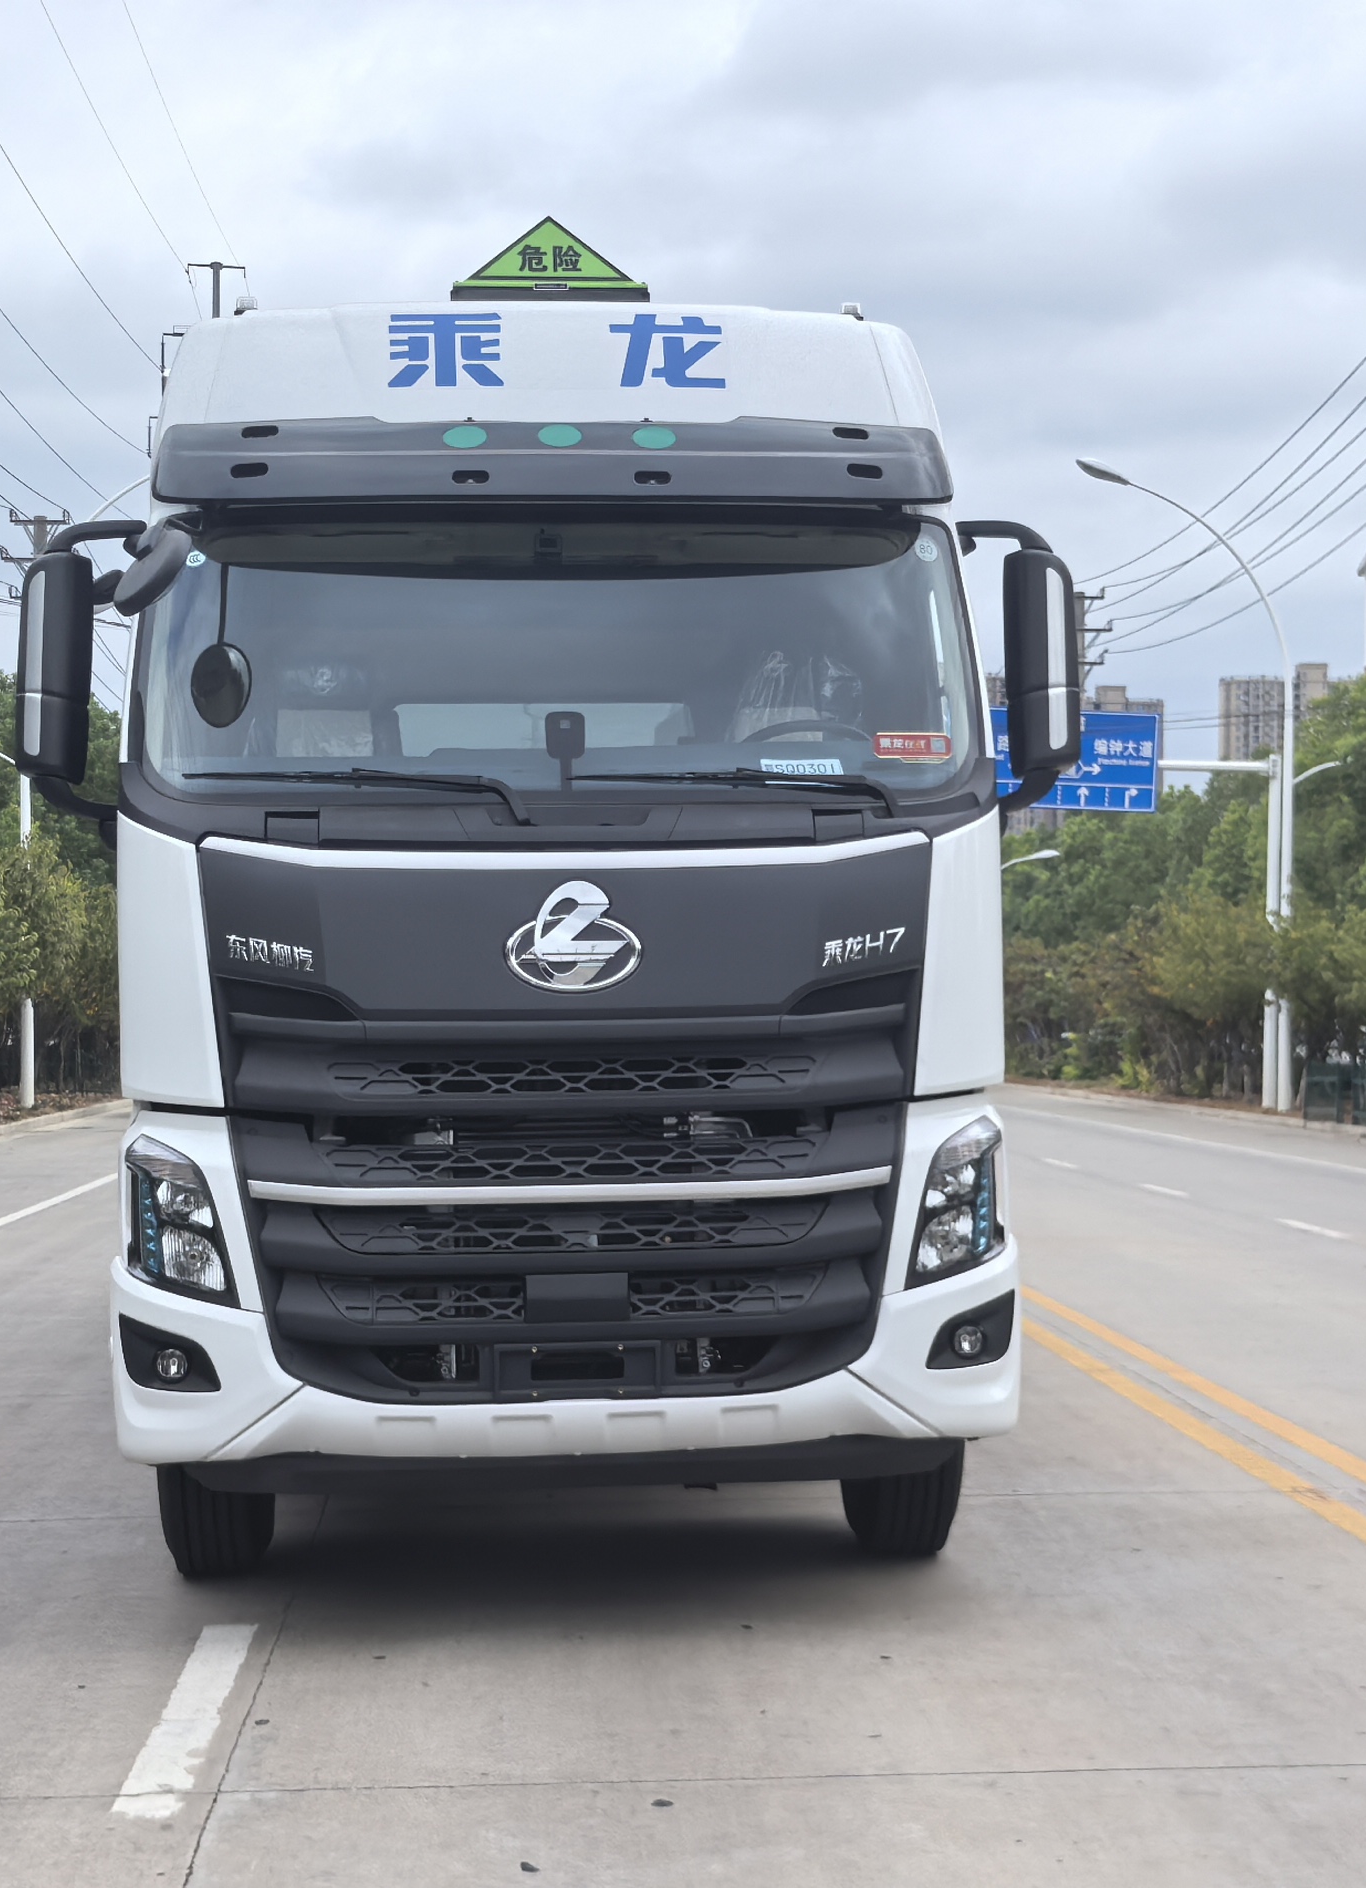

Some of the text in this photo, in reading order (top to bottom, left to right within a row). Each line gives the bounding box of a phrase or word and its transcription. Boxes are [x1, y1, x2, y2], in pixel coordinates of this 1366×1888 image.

[517, 244, 583, 273] 危险
[389, 313, 726, 388] 乘龙
[919, 543, 933, 556] 80
[225, 934, 315, 972] 东风柳汽
[821, 926, 906, 967] 乘龙H7
